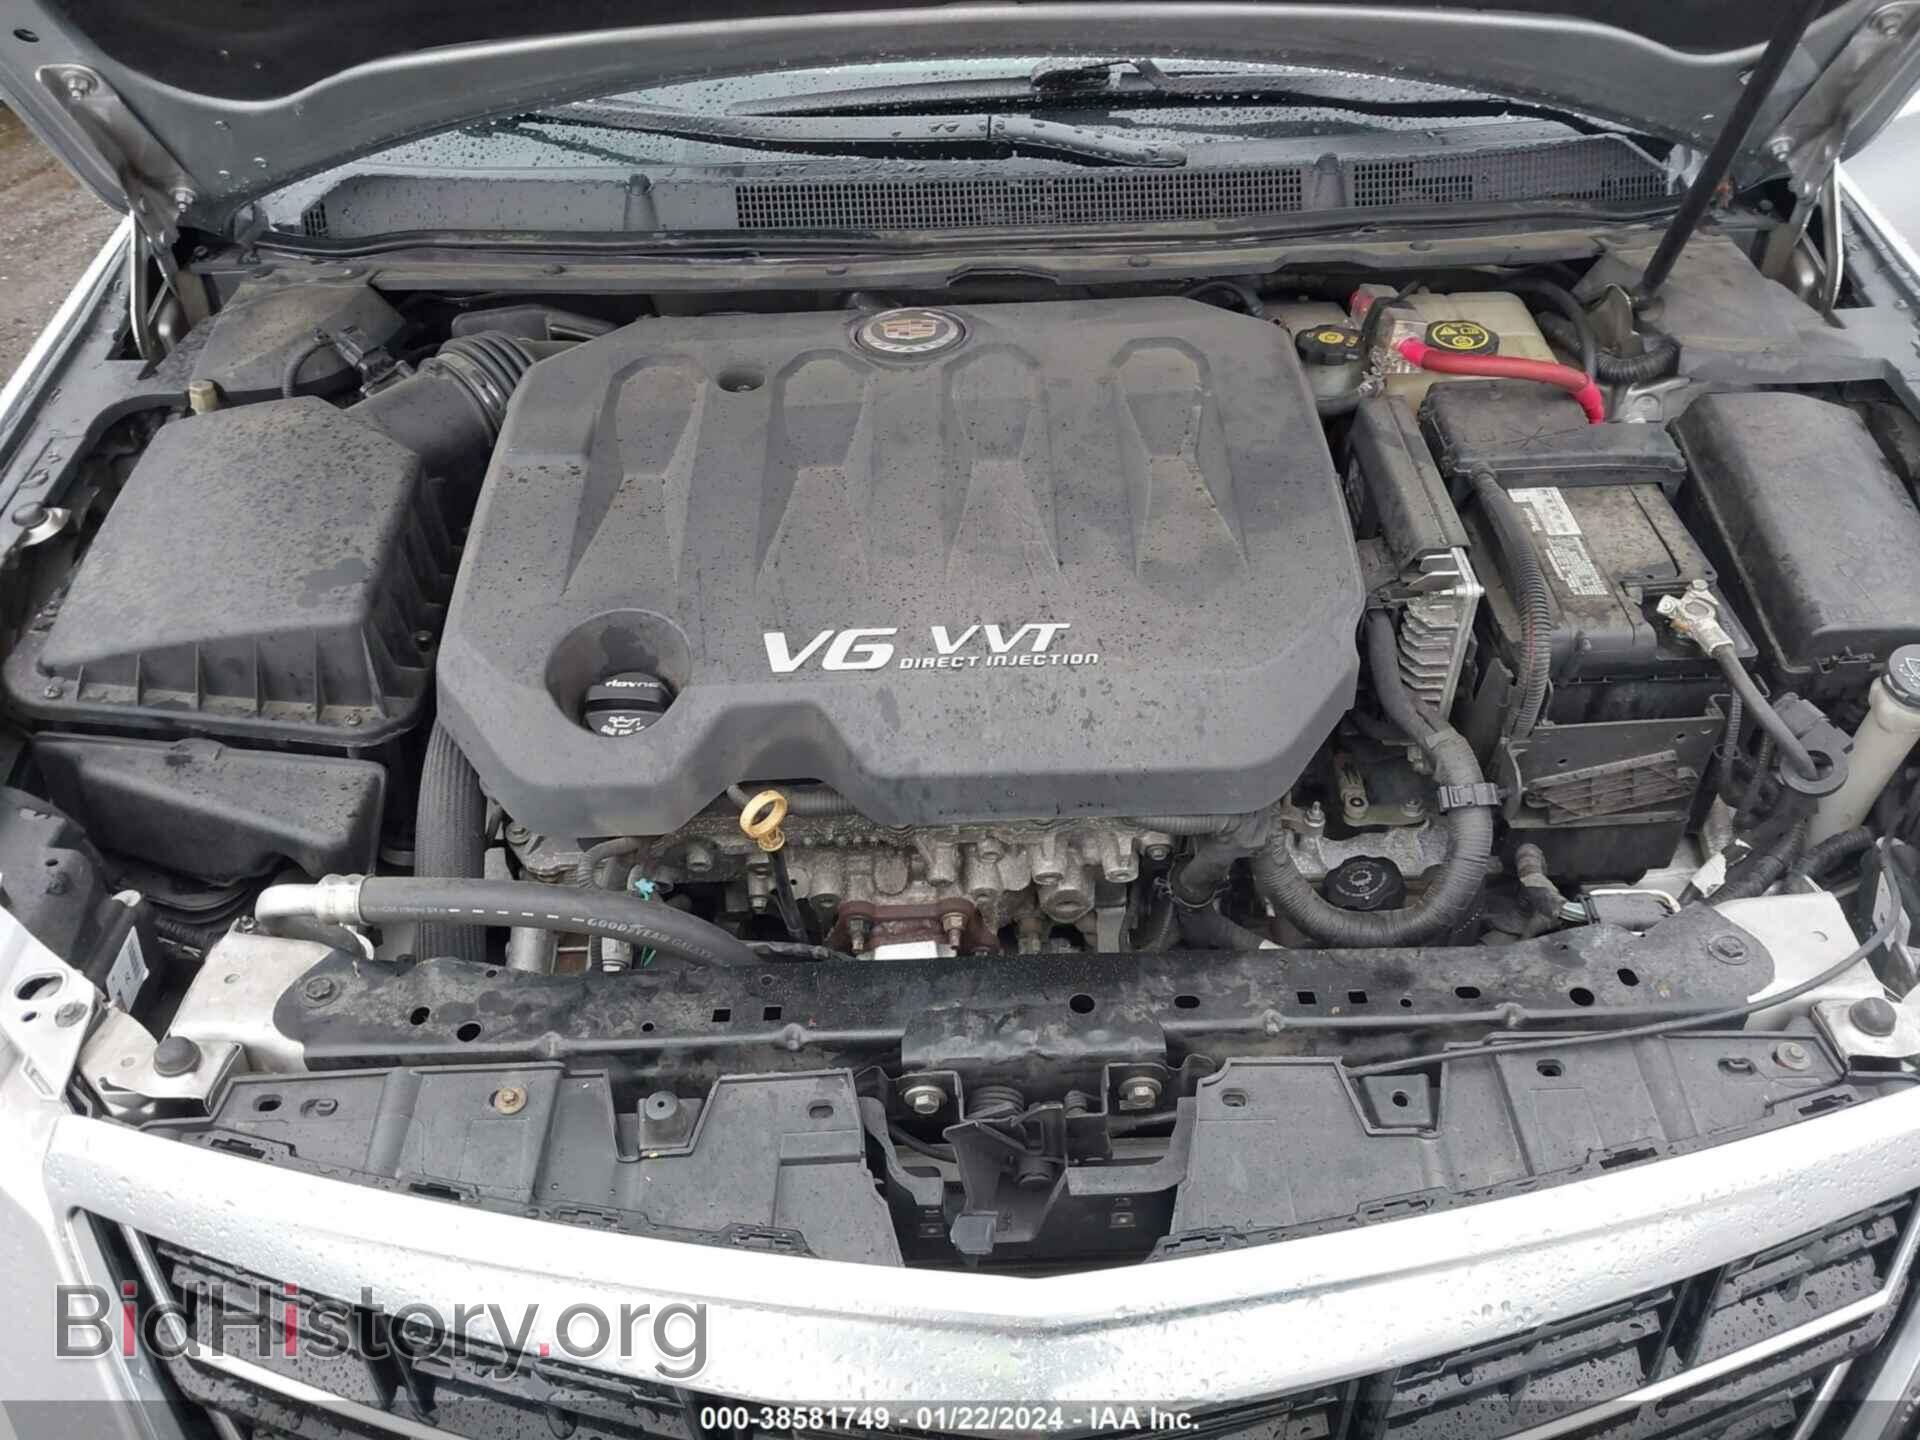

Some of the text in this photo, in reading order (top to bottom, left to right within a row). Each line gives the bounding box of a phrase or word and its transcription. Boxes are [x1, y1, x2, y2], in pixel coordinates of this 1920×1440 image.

[763, 623, 1071, 673] V6 VVT
[900, 653, 1099, 670] DIRECT INJECTION
[587, 917, 671, 943] GOODYEAR
